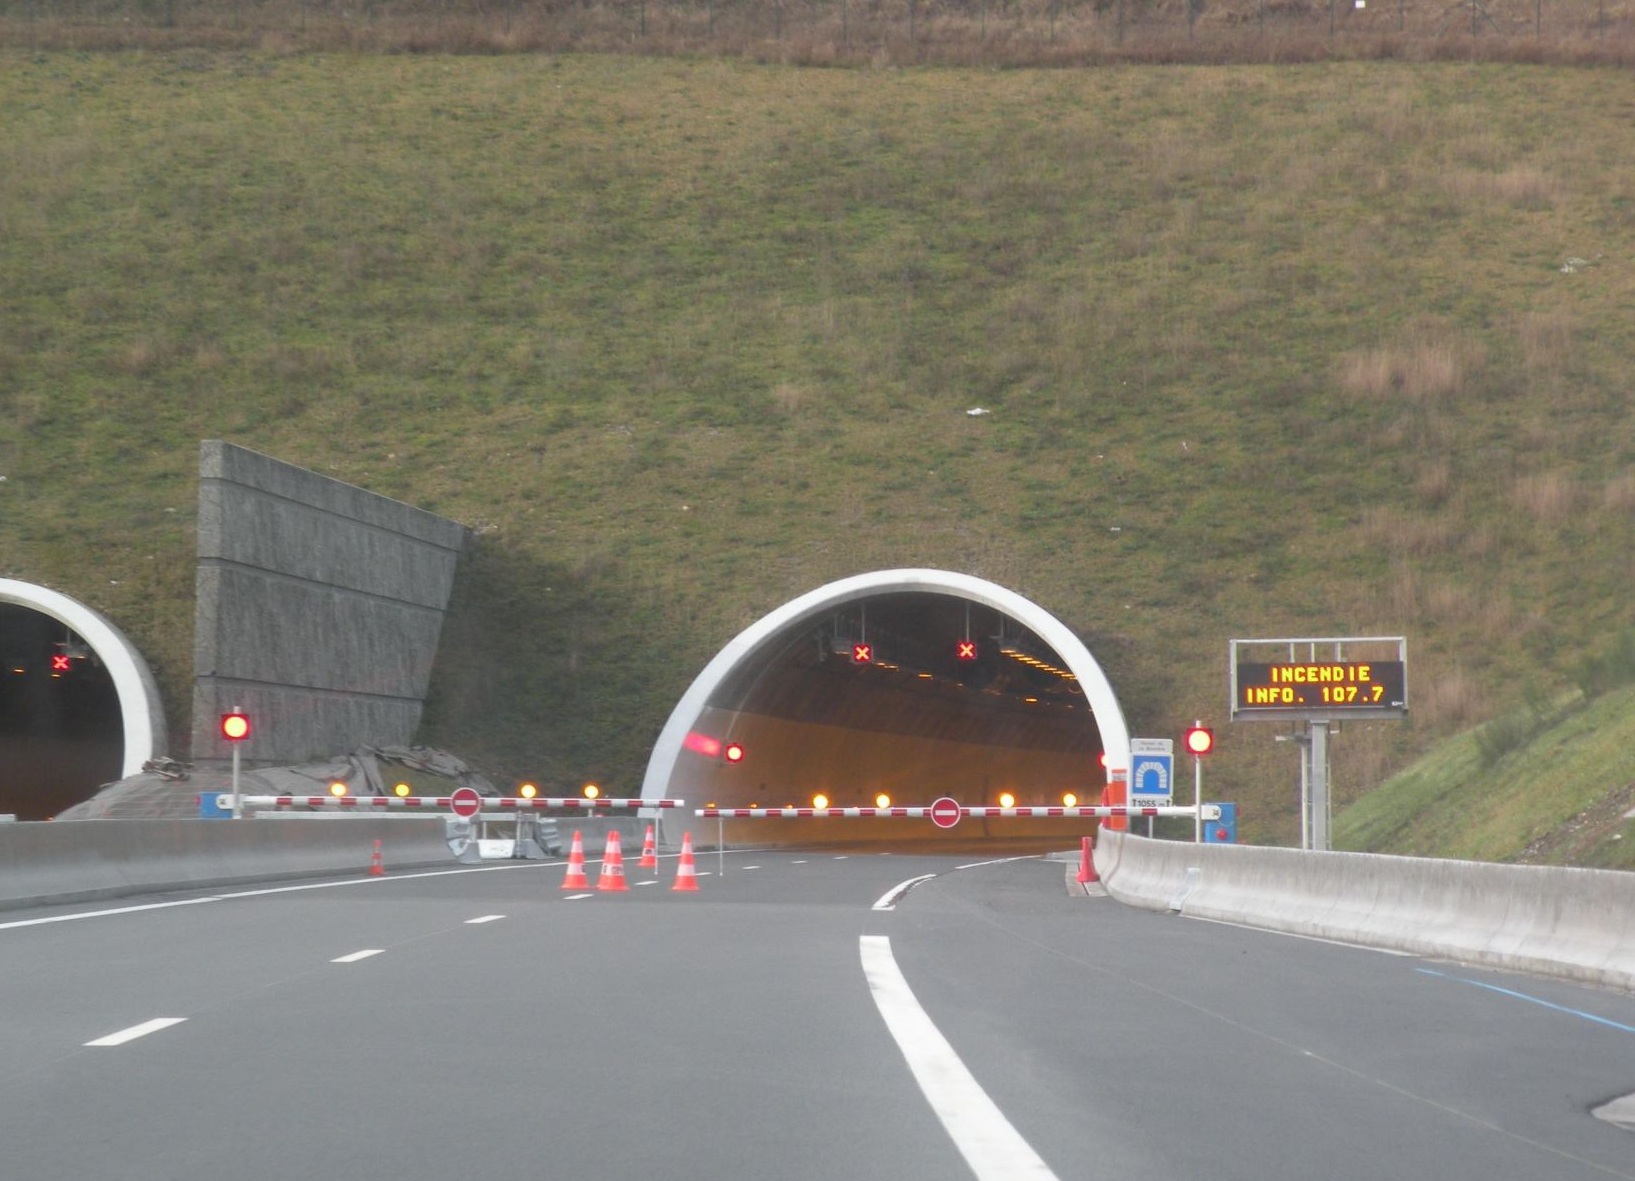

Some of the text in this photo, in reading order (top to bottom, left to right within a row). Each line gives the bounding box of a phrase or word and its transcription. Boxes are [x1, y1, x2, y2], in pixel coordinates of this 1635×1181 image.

[1271, 665, 1371, 683] INCENDIE
[1246, 685, 1384, 704] INFO. 107.7
[1137, 799, 1156, 808] 1055
